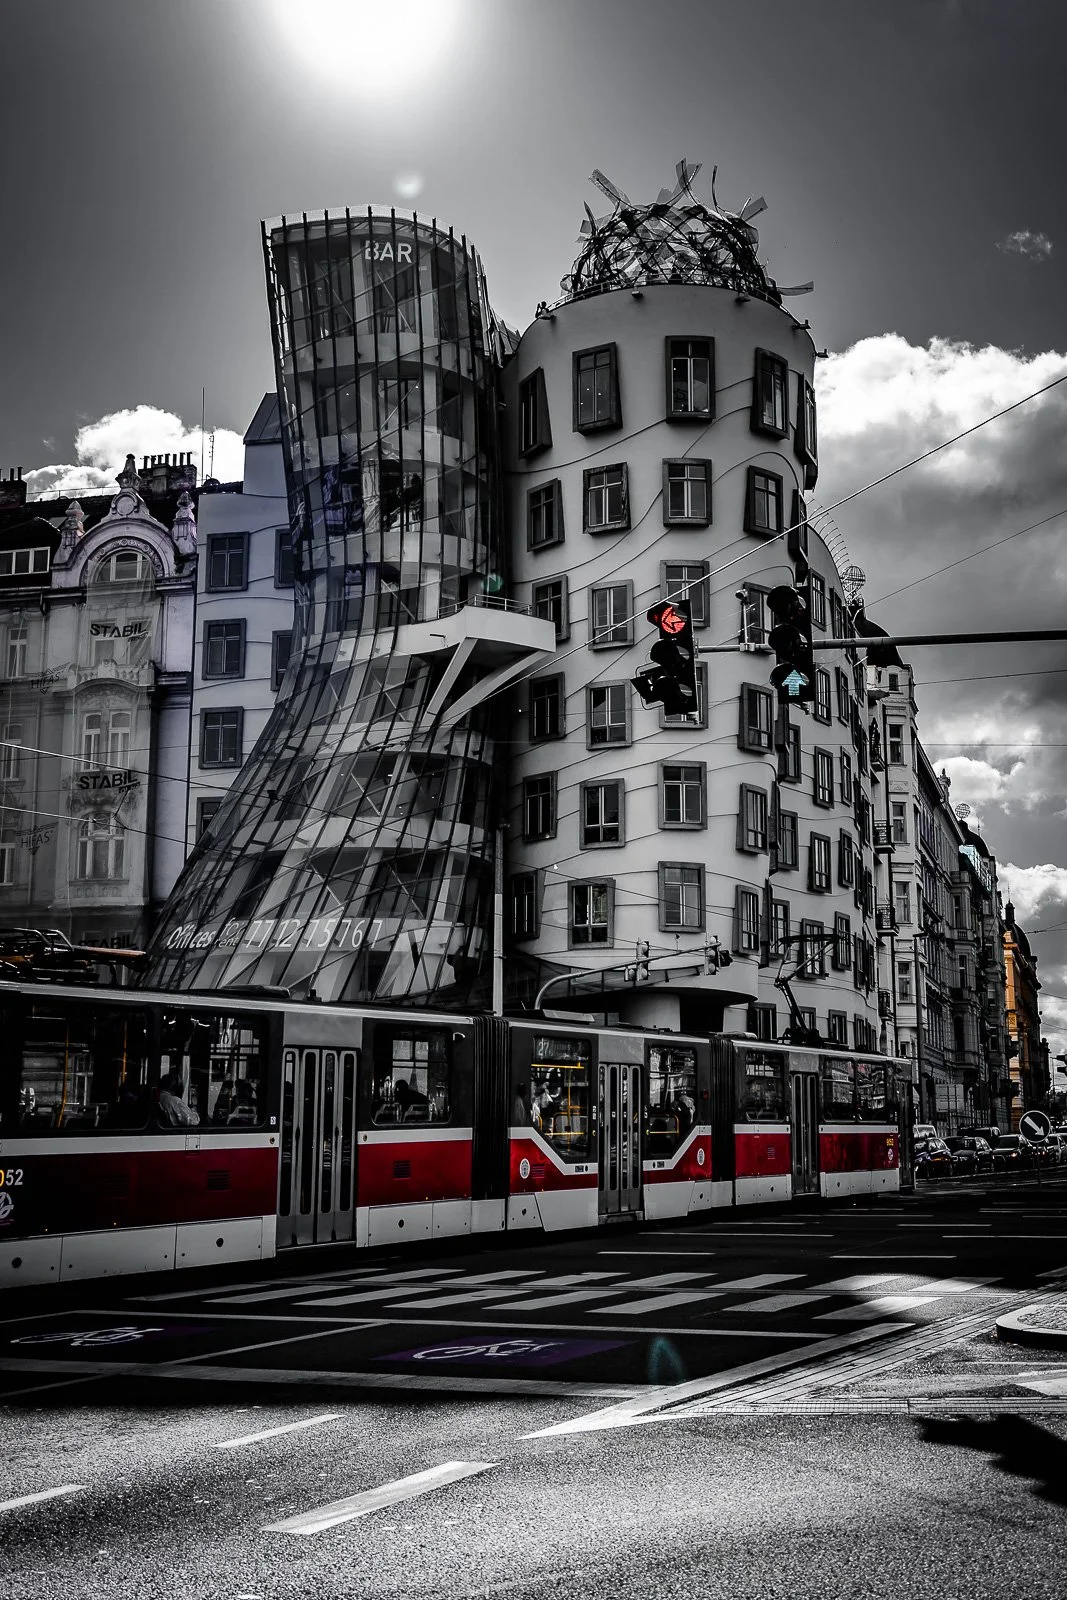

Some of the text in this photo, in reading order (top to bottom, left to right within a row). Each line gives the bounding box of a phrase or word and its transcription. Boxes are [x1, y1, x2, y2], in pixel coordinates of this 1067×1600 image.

[364, 239, 412, 264] BAR
[90, 623, 147, 638] STABIL
[80, 770, 138, 789] STABIL
[167, 924, 217, 950] Offices
